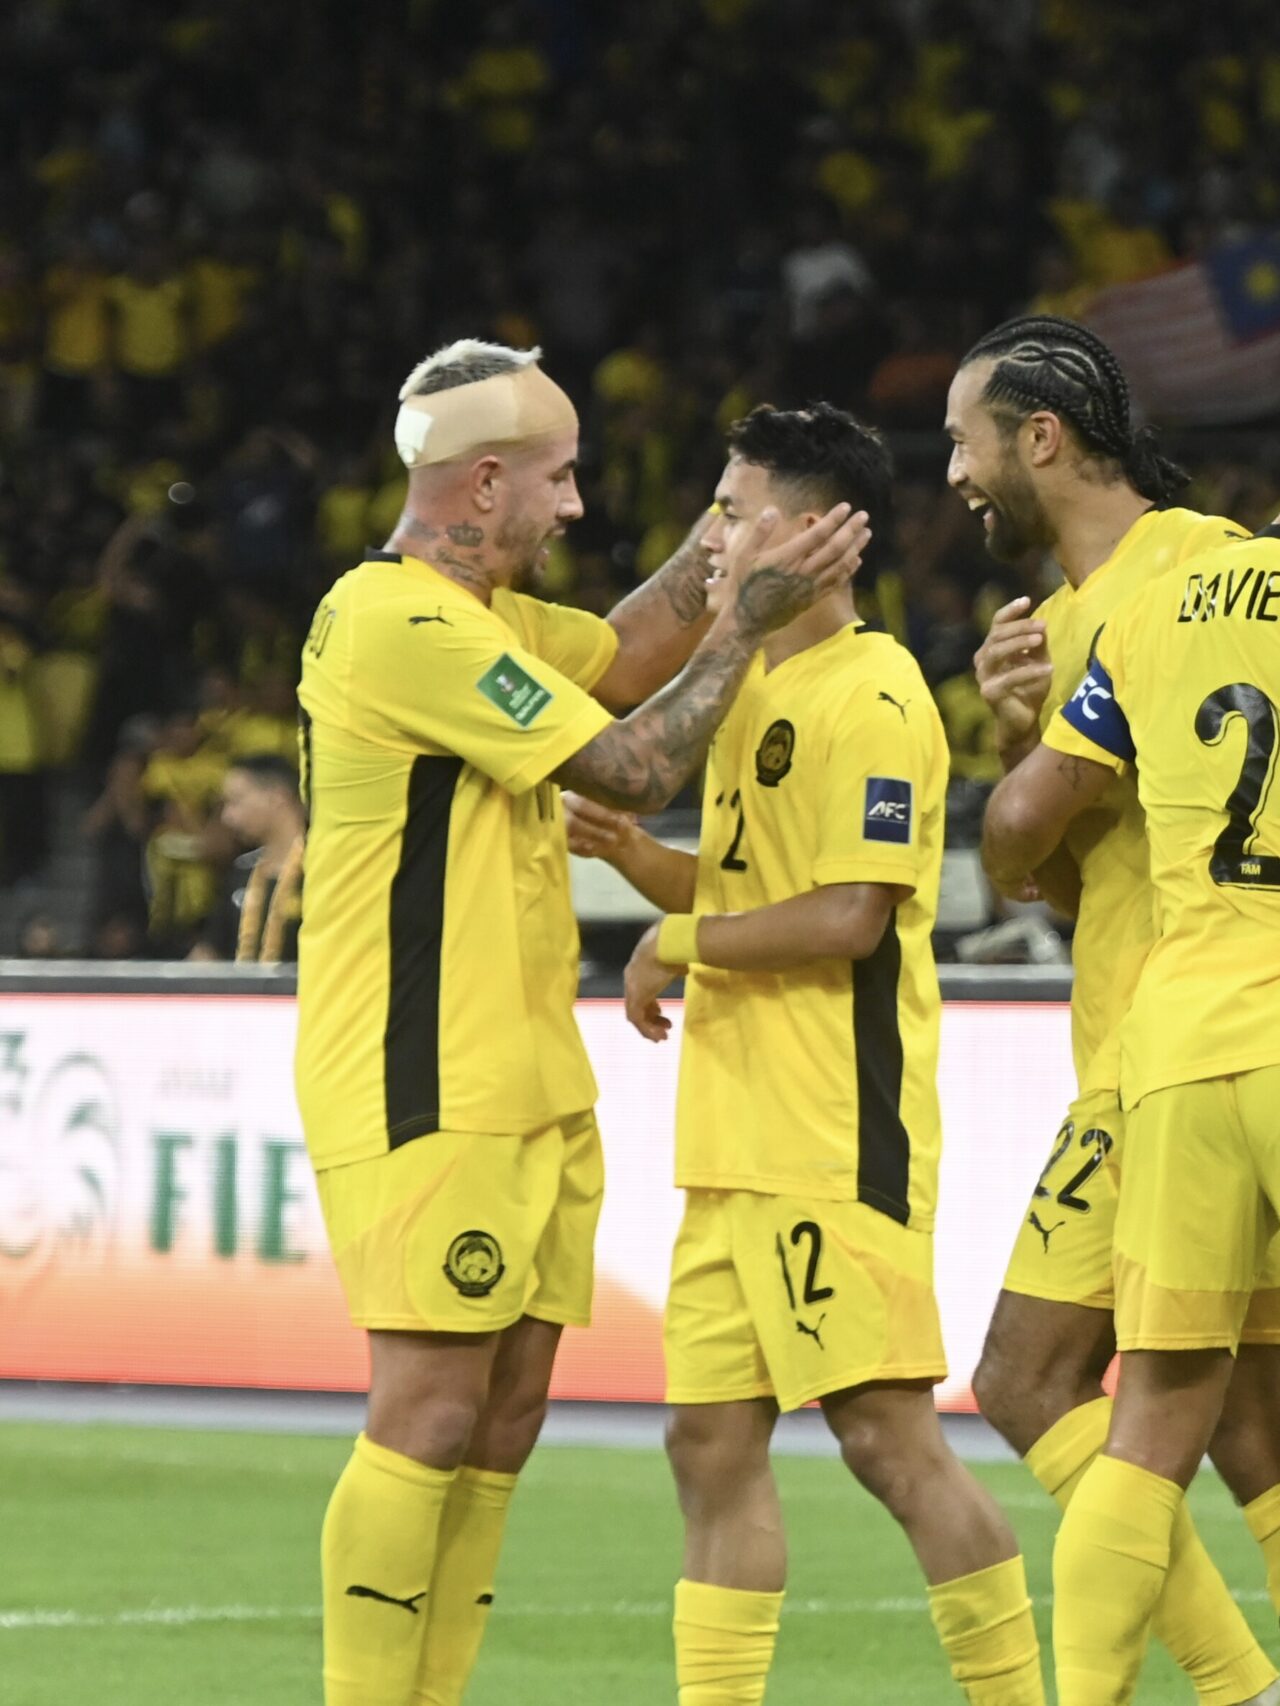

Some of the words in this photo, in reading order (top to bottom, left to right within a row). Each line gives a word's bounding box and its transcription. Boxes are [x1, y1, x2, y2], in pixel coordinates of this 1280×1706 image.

[1070, 674, 1113, 721] FC
[868, 800, 907, 820] AFC
[1240, 863, 1261, 875] FAM
[1034, 1120, 1114, 1213] 22
[775, 1221, 834, 1311] 12
